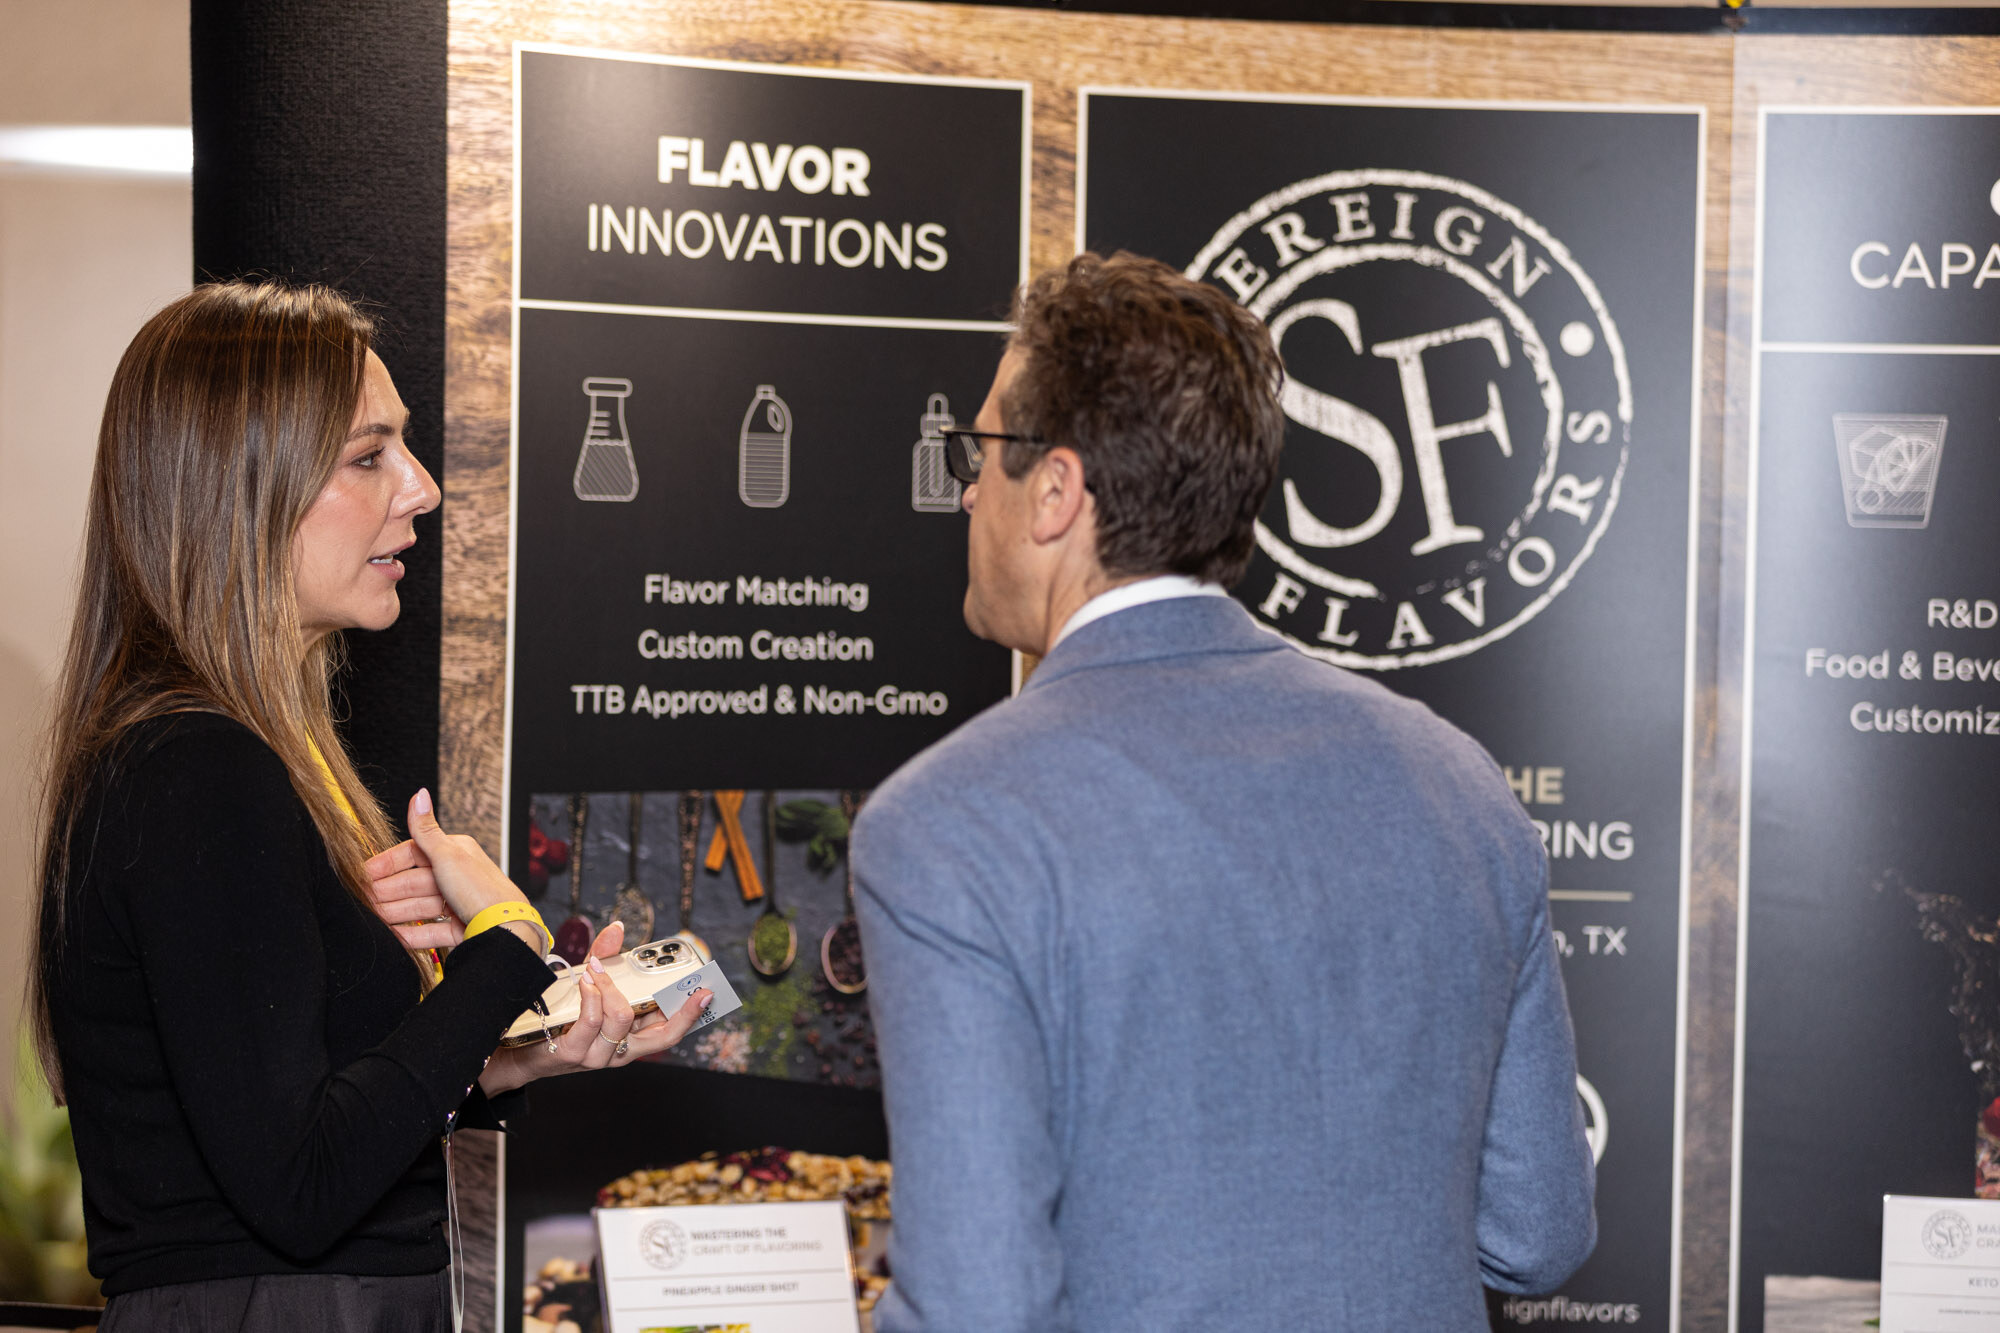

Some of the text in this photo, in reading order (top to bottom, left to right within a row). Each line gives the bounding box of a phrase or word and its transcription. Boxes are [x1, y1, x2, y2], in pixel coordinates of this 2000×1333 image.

[658, 136, 871, 196] FLAVOR
[588, 203, 948, 272] INNOVATIONS
[1850, 241, 2000, 289] CAPA
[1268, 299, 1513, 555] SF
[1259, 410, 1612, 649] FLAVORS
[645, 573, 869, 612] Flavor Matching
[1928, 598, 1999, 629] R&D
[638, 629, 874, 661] Custom Creation
[1806, 648, 1890, 679] Food
[1899, 650, 1922, 680] &
[570, 684, 948, 719] TTB Approved & Non-Gmo
[1850, 701, 2000, 735] Customiz
[1582, 925, 1628, 956] TX
[764, 1226, 787, 1238] THE
[1968, 1277, 1999, 1288] KETO
